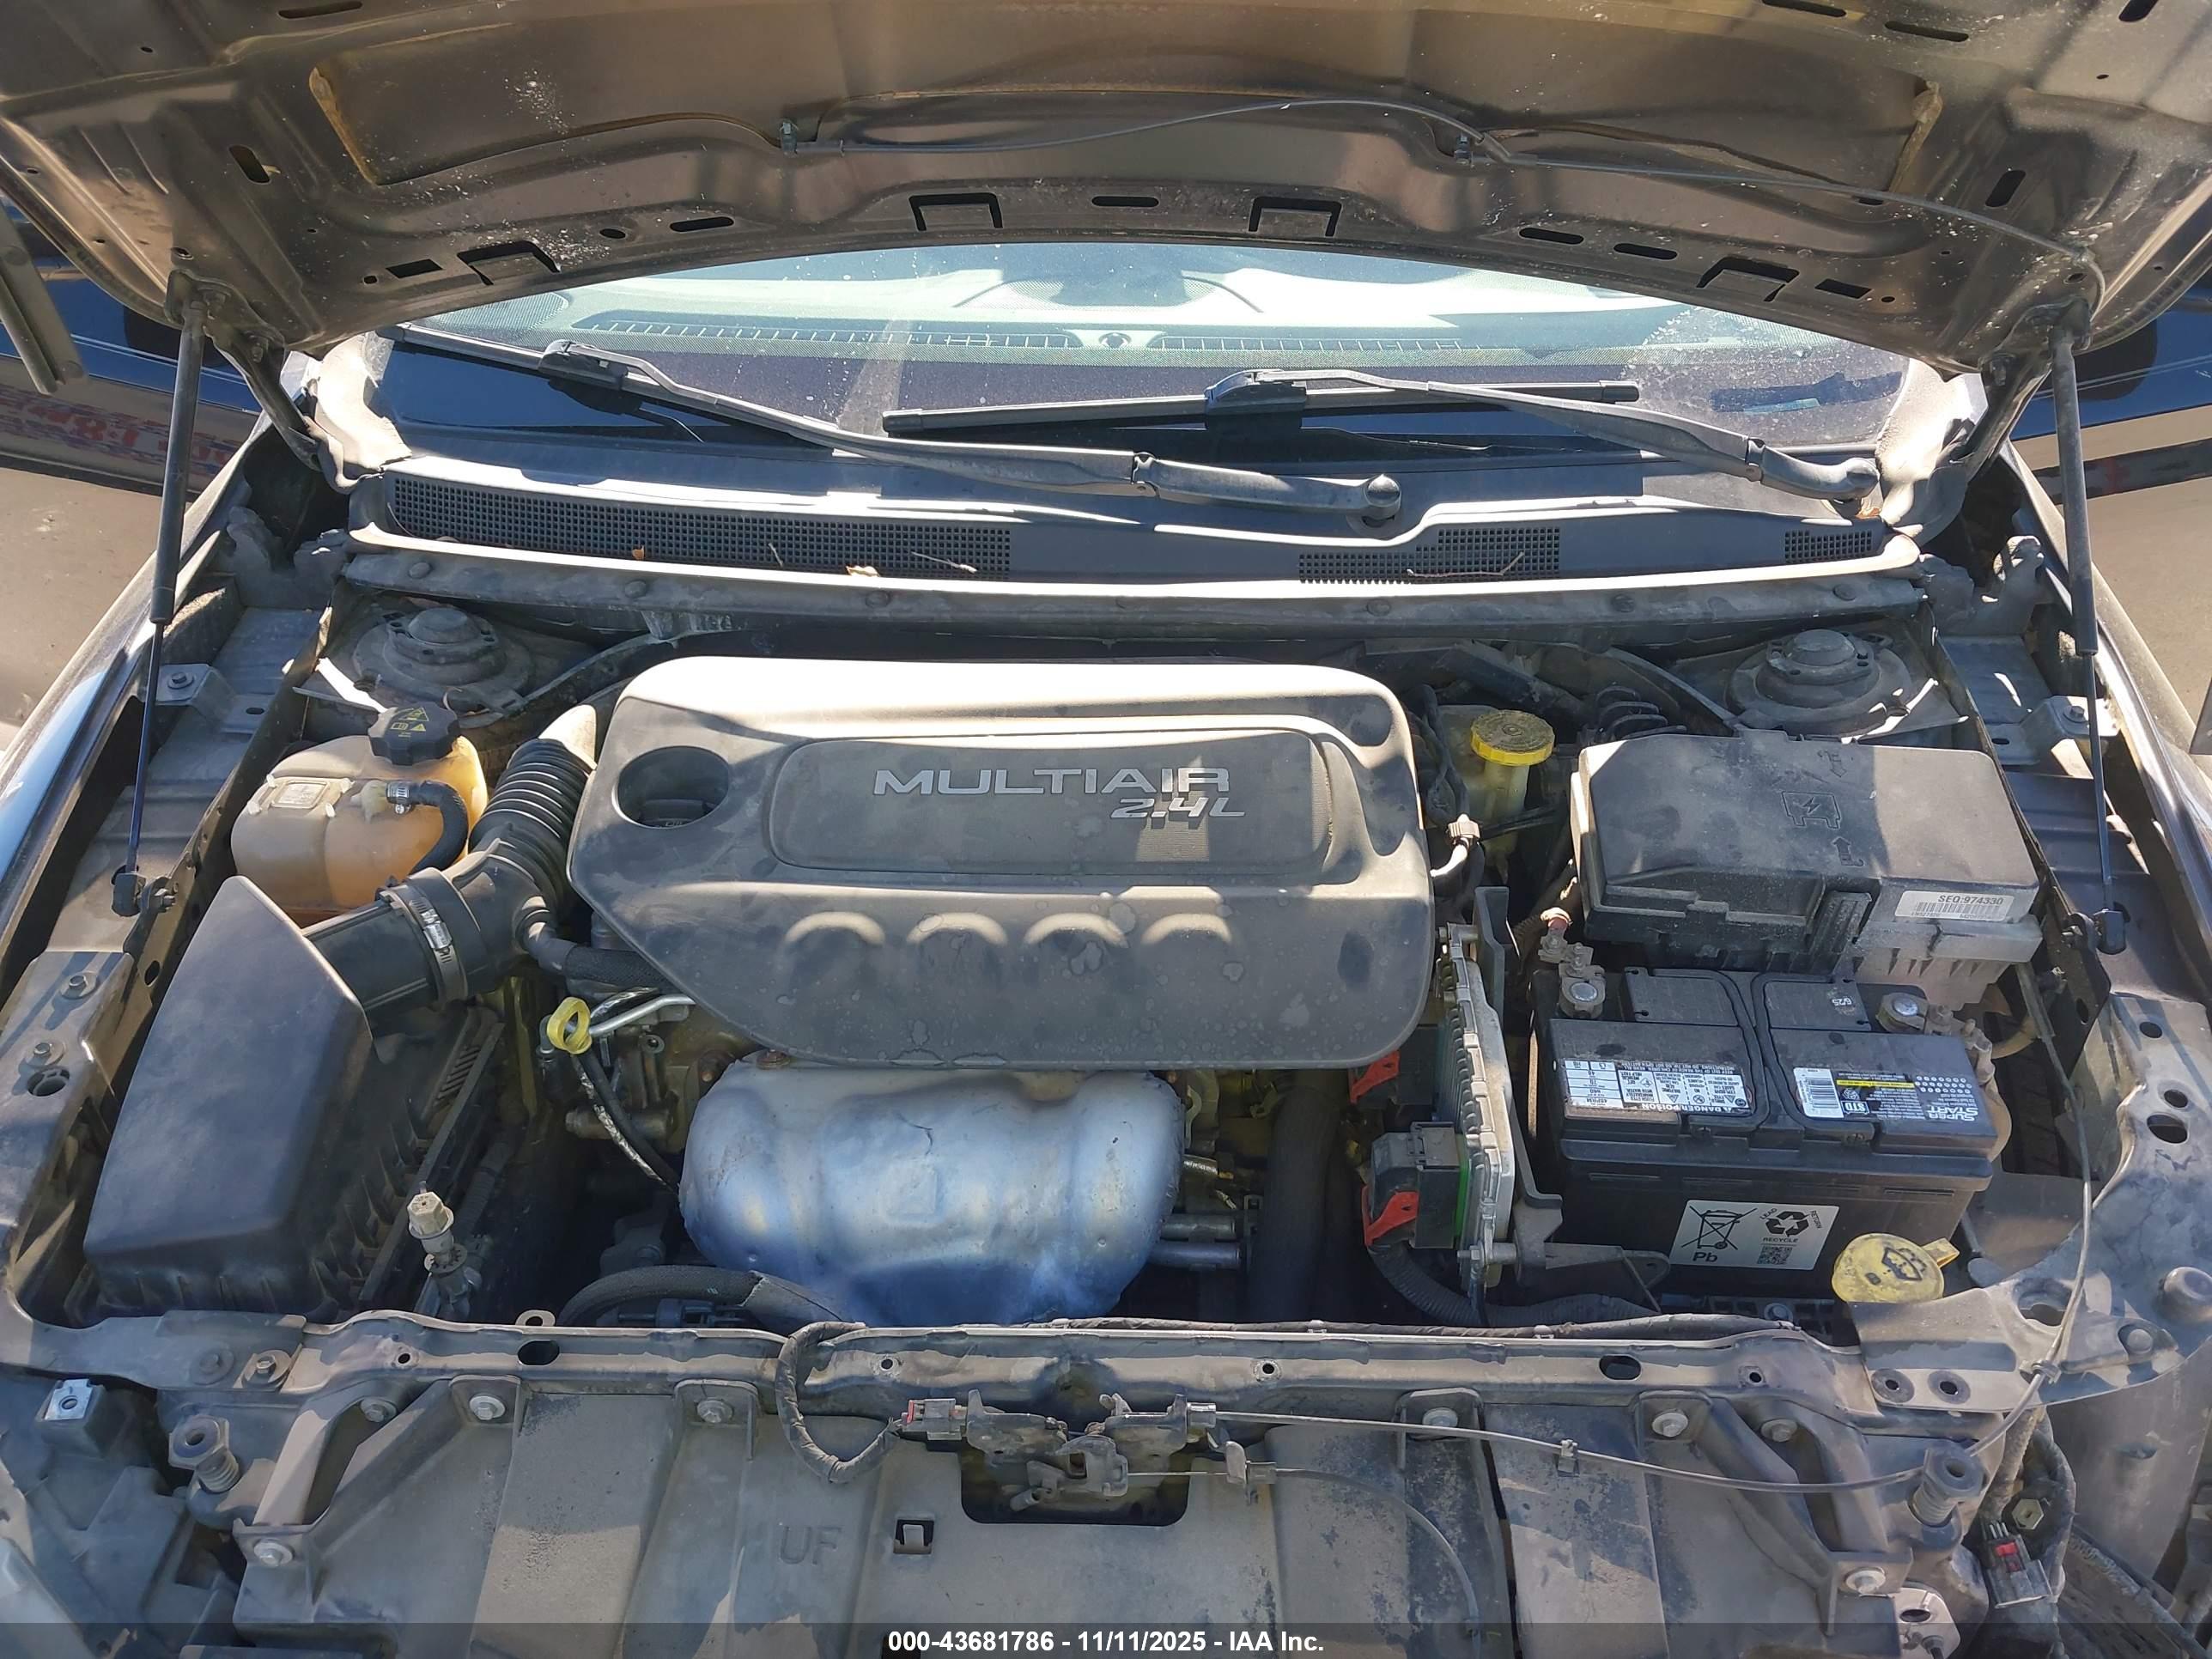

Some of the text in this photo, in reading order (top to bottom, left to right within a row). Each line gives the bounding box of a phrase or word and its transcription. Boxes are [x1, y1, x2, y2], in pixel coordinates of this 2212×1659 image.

[873, 768, 1229, 794] MULTIAIR
[1110, 797, 1245, 818] 2.4L
[1844, 1102, 1865, 1111] STD
[1928, 1105, 1978, 1115] START
[1929, 1113, 1975, 1121] SUPER
[1759, 1207, 1778, 1220] LEAD
[1810, 1210, 1823, 1229] RETURN
[1692, 1251, 1717, 1263] Pb
[780, 1526, 842, 1565] UF
